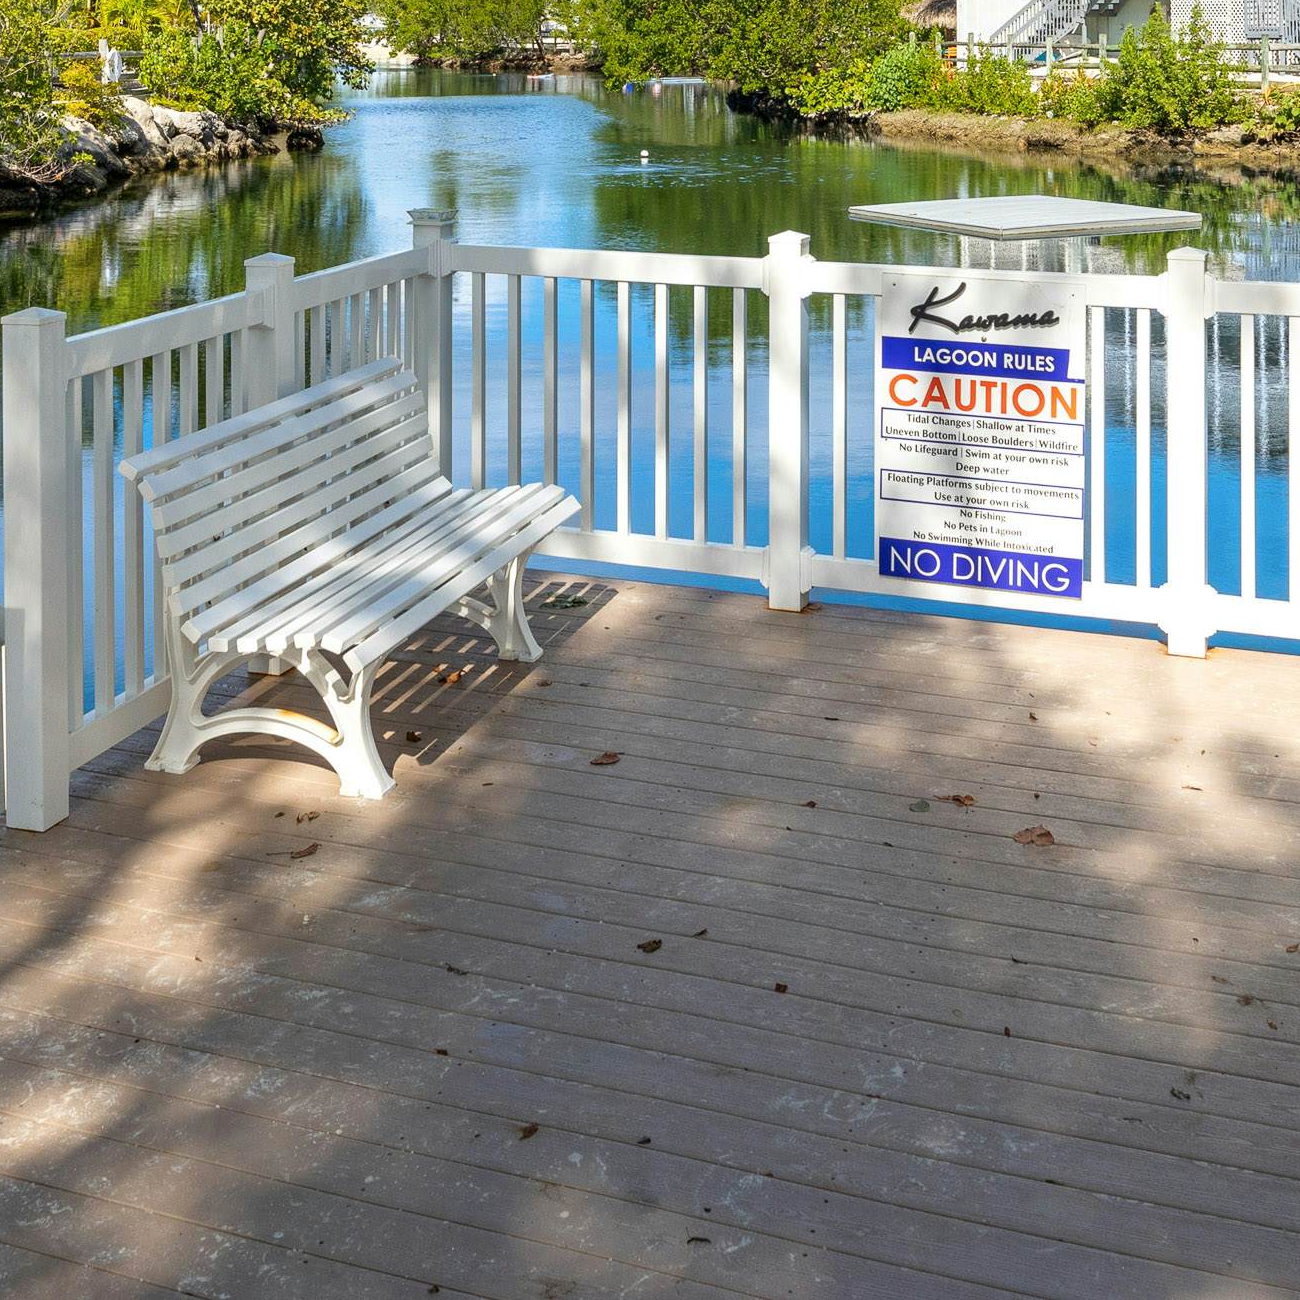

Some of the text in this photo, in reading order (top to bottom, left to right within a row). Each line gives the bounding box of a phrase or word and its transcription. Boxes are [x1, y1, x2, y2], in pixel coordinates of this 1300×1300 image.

[908, 282, 1060, 335] Kawama
[914, 347, 1055, 373] LAGOON RULES
[888, 373, 1078, 420] CAUTION
[885, 426, 920, 437] Uneven
[906, 413, 929, 423] Tidal
[1015, 425, 1025, 433] at
[1028, 424, 1056, 435] Times
[899, 443, 912, 452] No
[915, 444, 958, 456] Lifeguard
[965, 449, 990, 459] Swim
[1004, 455, 1025, 463] your
[1051, 457, 1069, 466] risk
[955, 462, 1009, 475] Deep water
[887, 472, 1080, 500] Floating Platforms subject to movements
[934, 491, 1029, 509] Use at your own risk
[959, 509, 1006, 522] No Fishing
[943, 521, 1022, 536] No Pets in Lagoon
[913, 531, 1054, 553] No Swimming While Intoxicated
[890, 546, 1070, 592] NO DIVING
